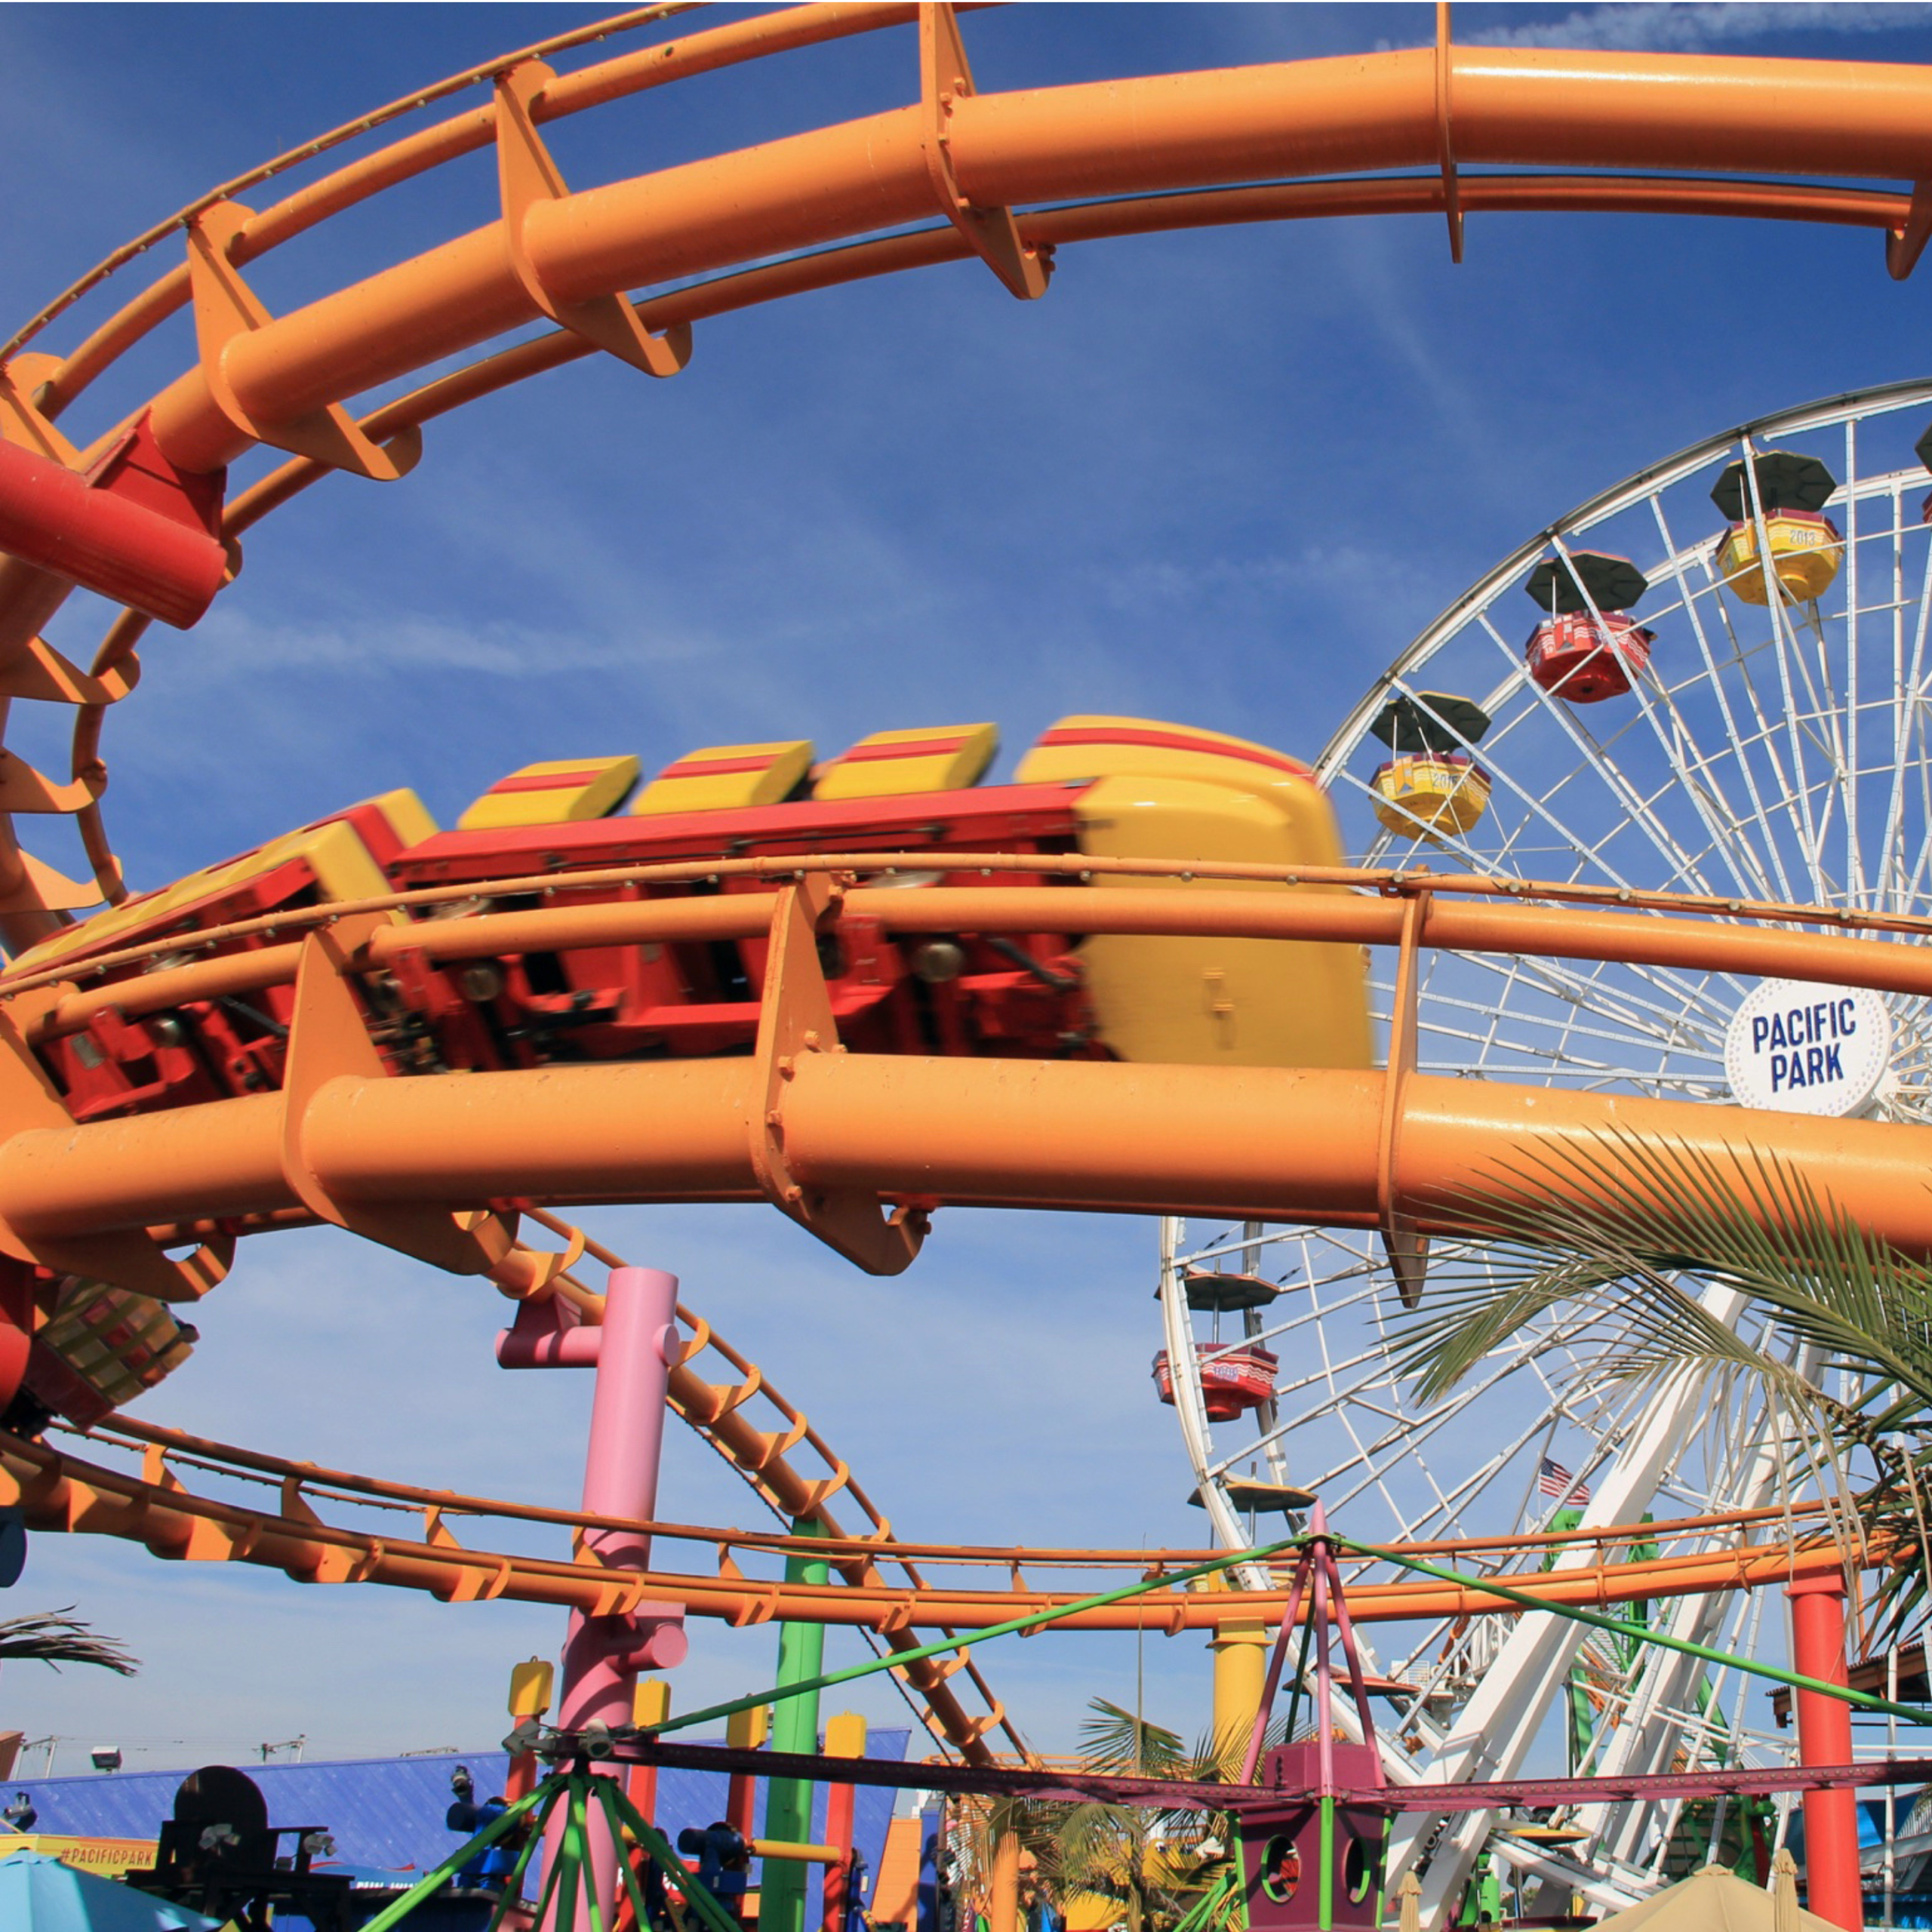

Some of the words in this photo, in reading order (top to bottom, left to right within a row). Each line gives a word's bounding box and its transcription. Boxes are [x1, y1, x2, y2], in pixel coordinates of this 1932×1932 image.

[1789, 530, 1815, 546] 2013
[1752, 998, 1856, 1054] PACIFIC
[1770, 1042, 1844, 1093] PARK
[61, 1847, 152, 1866] #PACIFICPARK
